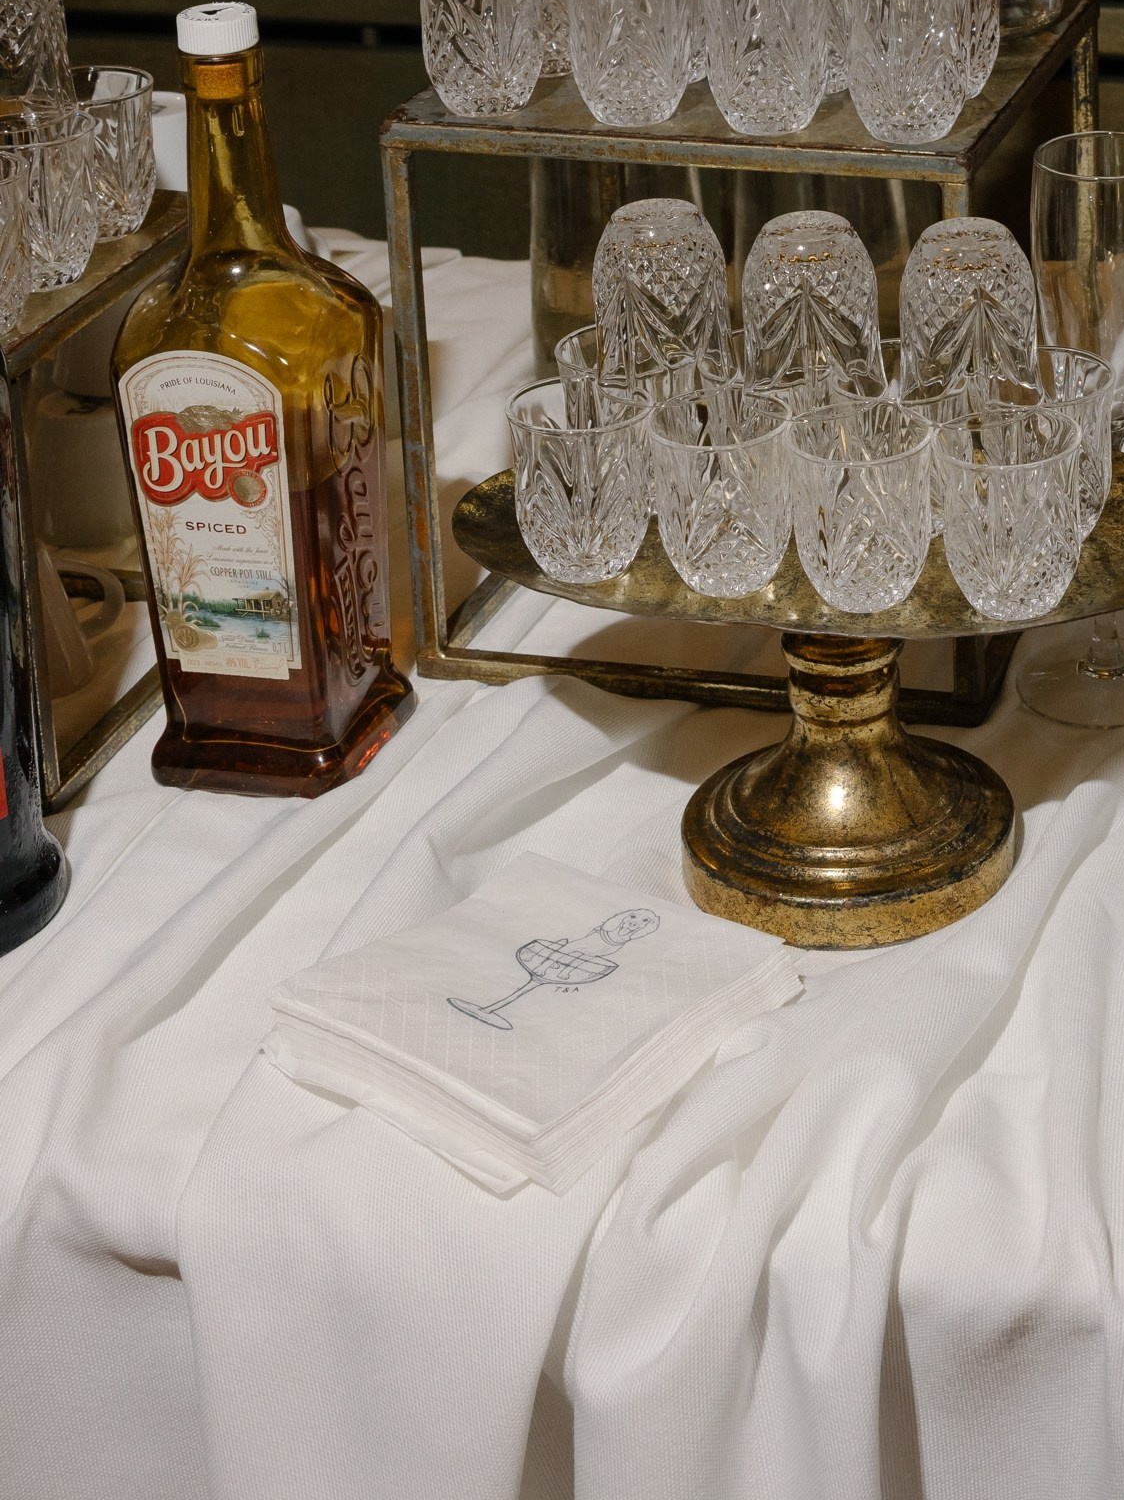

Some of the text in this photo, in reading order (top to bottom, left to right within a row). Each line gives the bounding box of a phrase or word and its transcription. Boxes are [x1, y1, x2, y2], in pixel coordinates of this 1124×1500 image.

[159, 377, 237, 396] PRIDE OF LOUISIANA
[142, 423, 272, 492] Bayou
[185, 521, 247, 535] SPICED
[210, 566, 272, 581] COPPER-POT STILL
